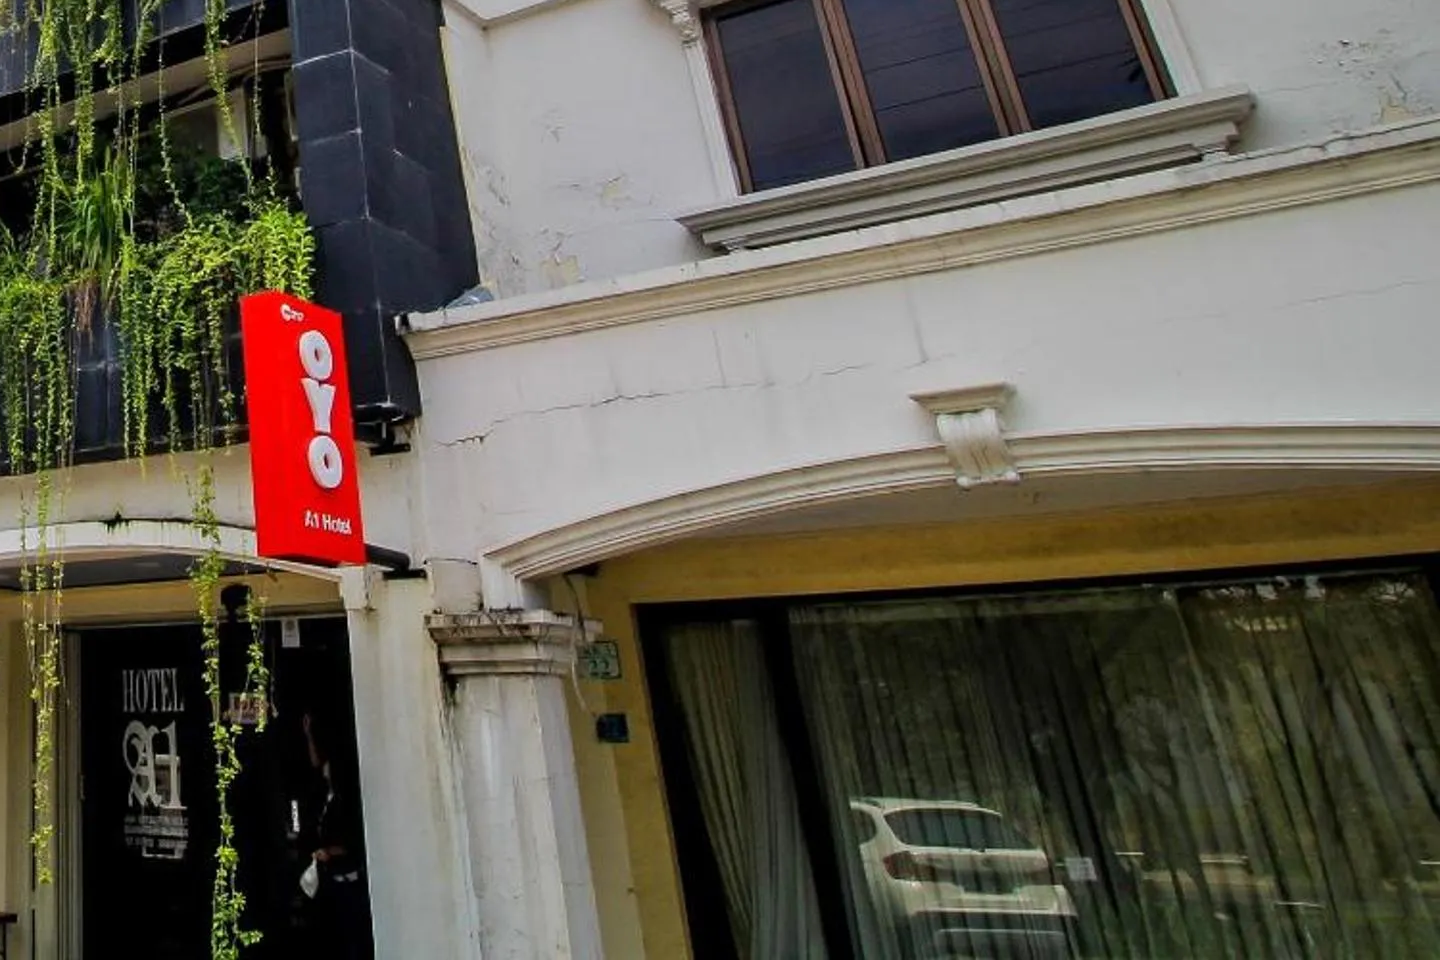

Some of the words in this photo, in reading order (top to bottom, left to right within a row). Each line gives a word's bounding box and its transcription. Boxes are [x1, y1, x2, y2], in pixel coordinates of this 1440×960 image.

[298, 330, 343, 489] OYO
[304, 510, 320, 528] A1
[322, 513, 352, 535] Hotel
[122, 668, 185, 713] HOTEL
[123, 720, 188, 810] A1
